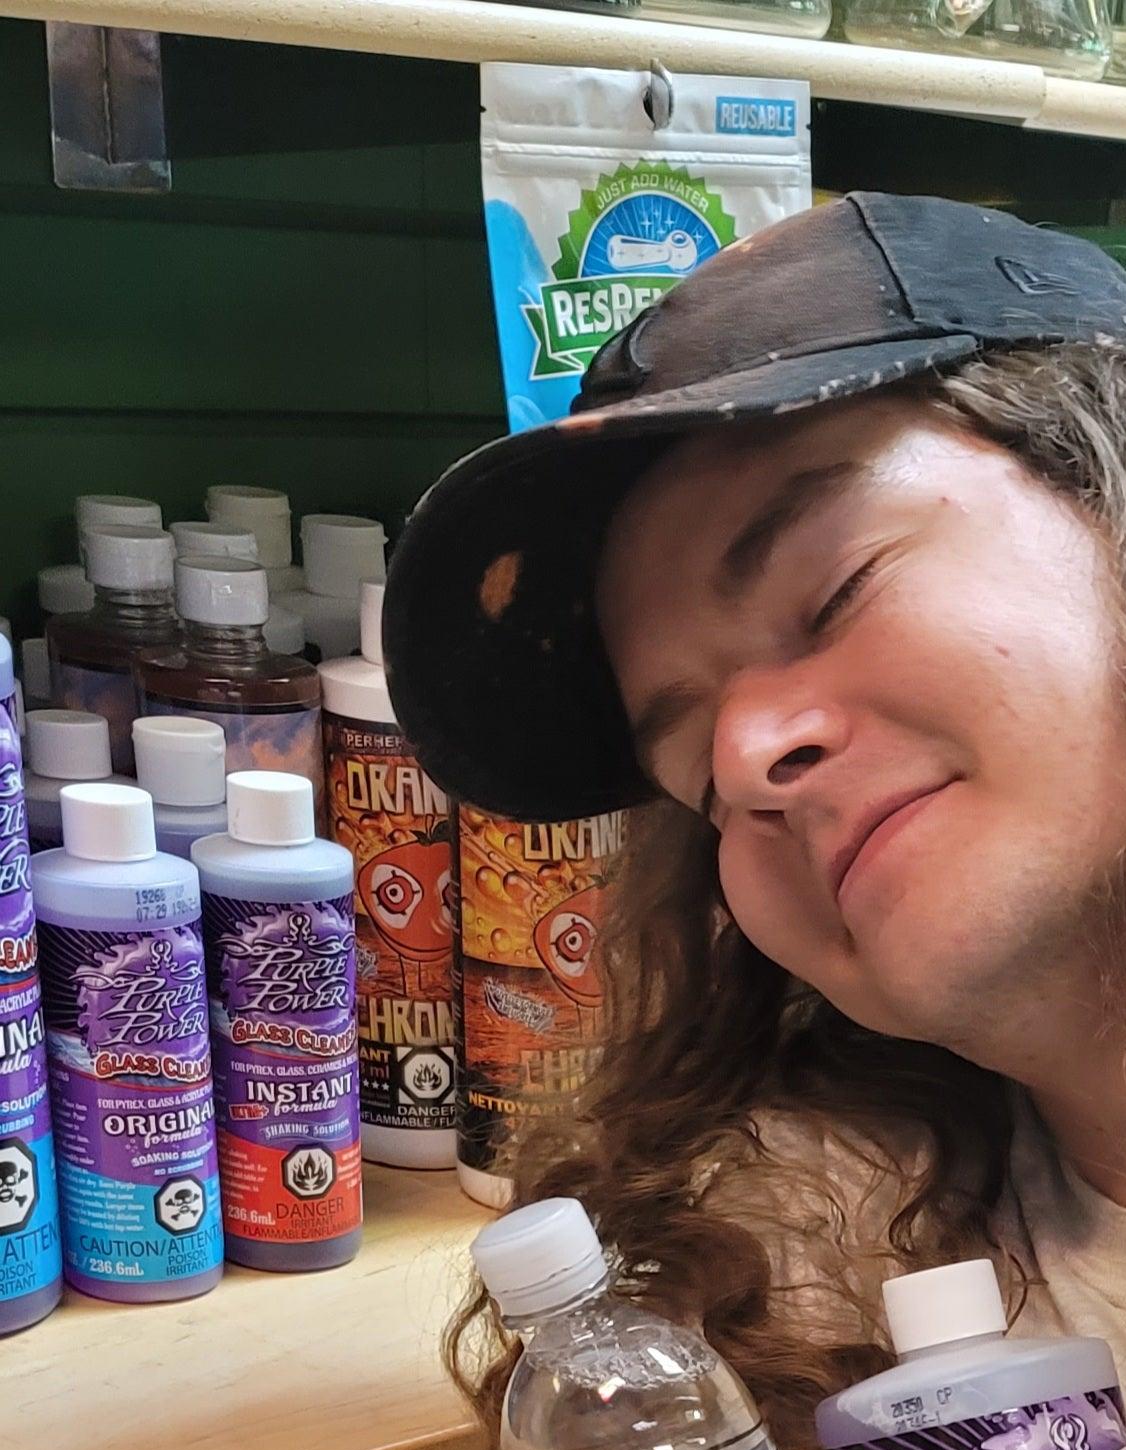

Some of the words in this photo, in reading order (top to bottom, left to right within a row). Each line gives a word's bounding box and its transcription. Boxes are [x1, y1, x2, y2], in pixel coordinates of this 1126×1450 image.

[719, 102, 793, 132] REUSABLE
[595, 178, 626, 211] JUST
[630, 173, 660, 190] ADD
[663, 175, 709, 213] WATER
[551, 283, 665, 338] RESRE
[346, 760, 448, 816] ORAN
[238, 947, 347, 992] PURPLE
[98, 978, 203, 1020] PURPLE
[235, 976, 349, 1012] POWER
[96, 1003, 206, 1047] POWER
[231, 1018, 293, 1046] GLASS
[95, 1052, 160, 1077] GLASS
[246, 1073, 352, 1103] INSTANT
[274, 1098, 338, 1116] formula
[144, 1127, 204, 1149] formula
[265, 1123, 310, 1139] SHAKING
[276, 1196, 345, 1219] DANGER
[89, 1257, 145, 1277] 236.6mL
[166, 1257, 209, 1278] IRRITANT
[168, 1249, 207, 1266] POISON
